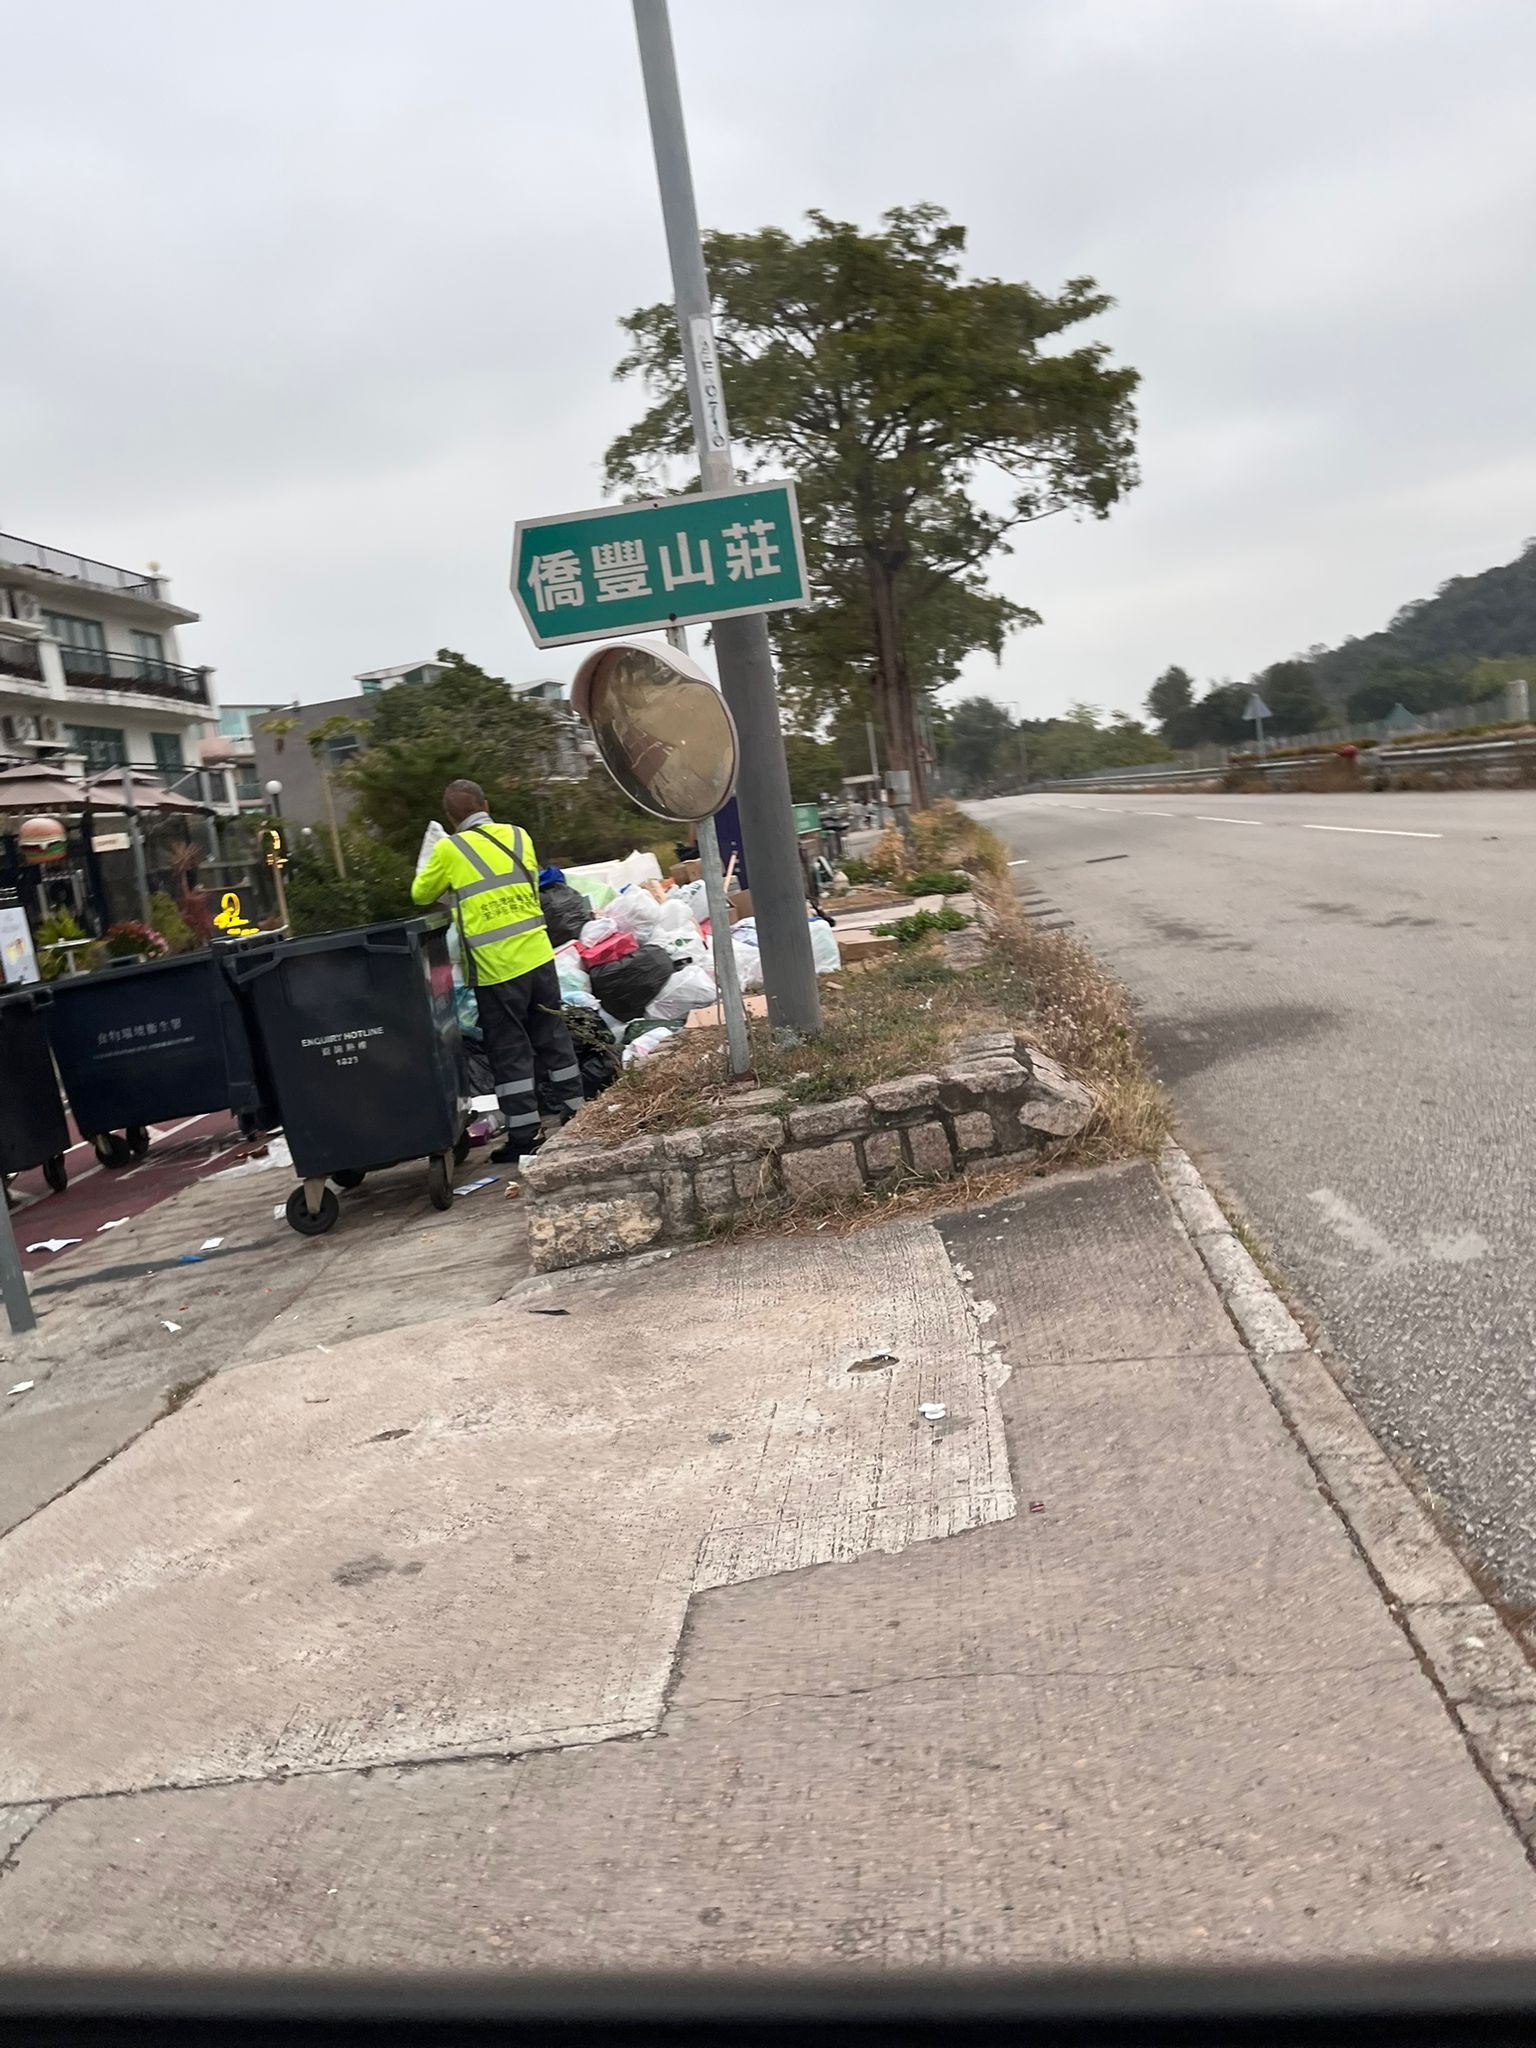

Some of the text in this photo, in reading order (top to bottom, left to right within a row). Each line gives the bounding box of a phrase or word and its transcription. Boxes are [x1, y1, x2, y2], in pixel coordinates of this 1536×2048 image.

[527, 519, 782, 612] 僑豐山莊
[301, 1027, 384, 1047] ENQUIRY HOTLINE
